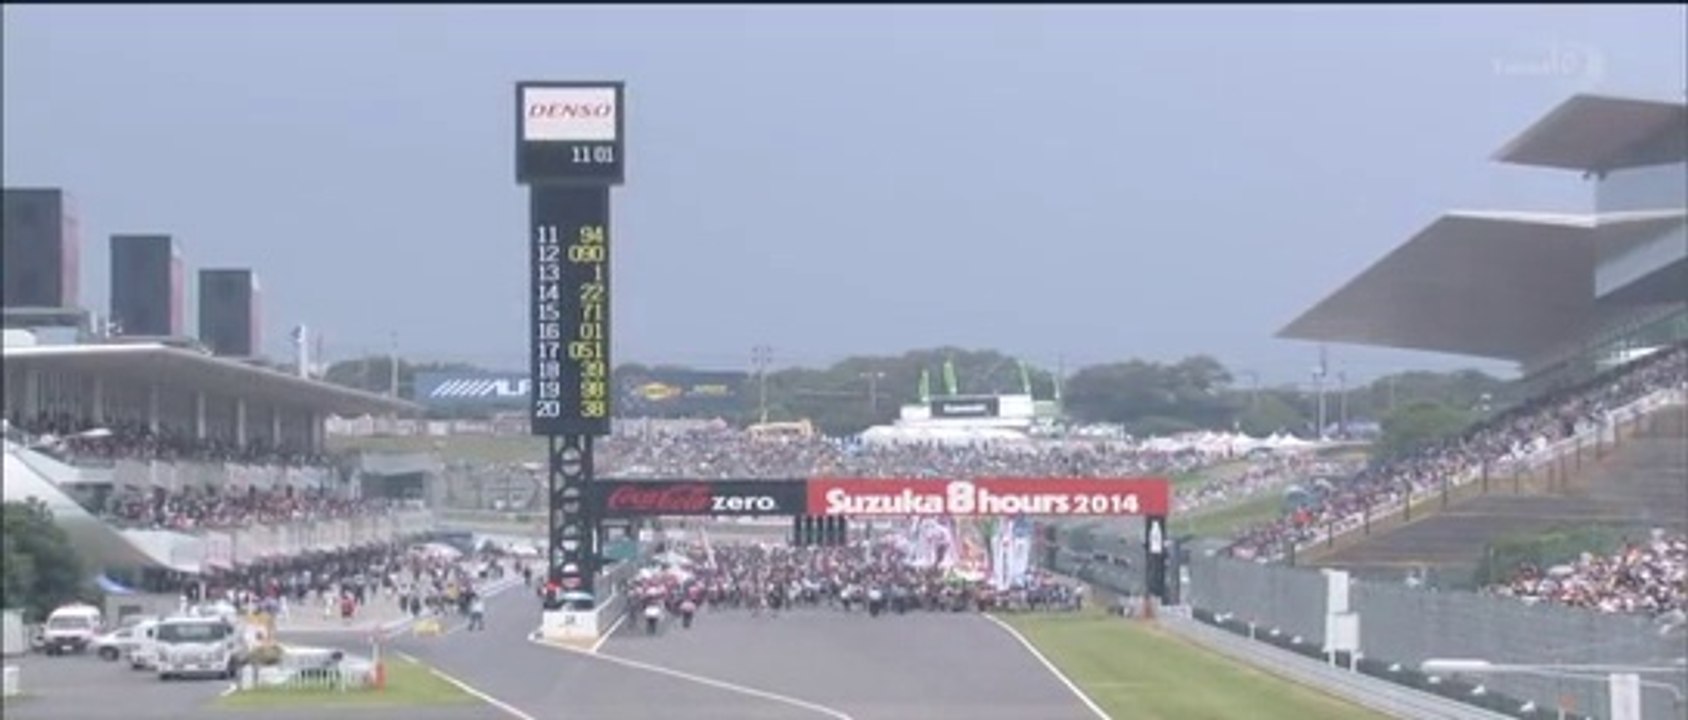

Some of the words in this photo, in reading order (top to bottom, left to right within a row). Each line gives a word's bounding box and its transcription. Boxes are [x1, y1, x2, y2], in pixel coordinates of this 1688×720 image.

[529, 102, 611, 118] DENSO
[539, 226, 557, 243] 11
[580, 226, 603, 243] 94
[539, 245, 560, 262] 12
[539, 264, 560, 281] 13
[595, 264, 602, 281] 1
[539, 283, 560, 300] 14
[580, 283, 603, 300] 22
[539, 303, 560, 319] 15
[583, 303, 602, 319] 71
[539, 322, 560, 339] 16
[539, 341, 560, 359] 17
[539, 380, 560, 398] 19
[537, 400, 561, 418] 20
[580, 400, 604, 418] 38
[711, 495, 775, 511] zero
[825, 487, 944, 514] Suzuka
[946, 480, 975, 513] 8
[977, 487, 1070, 514] hours
[1073, 492, 1139, 514] 2014
